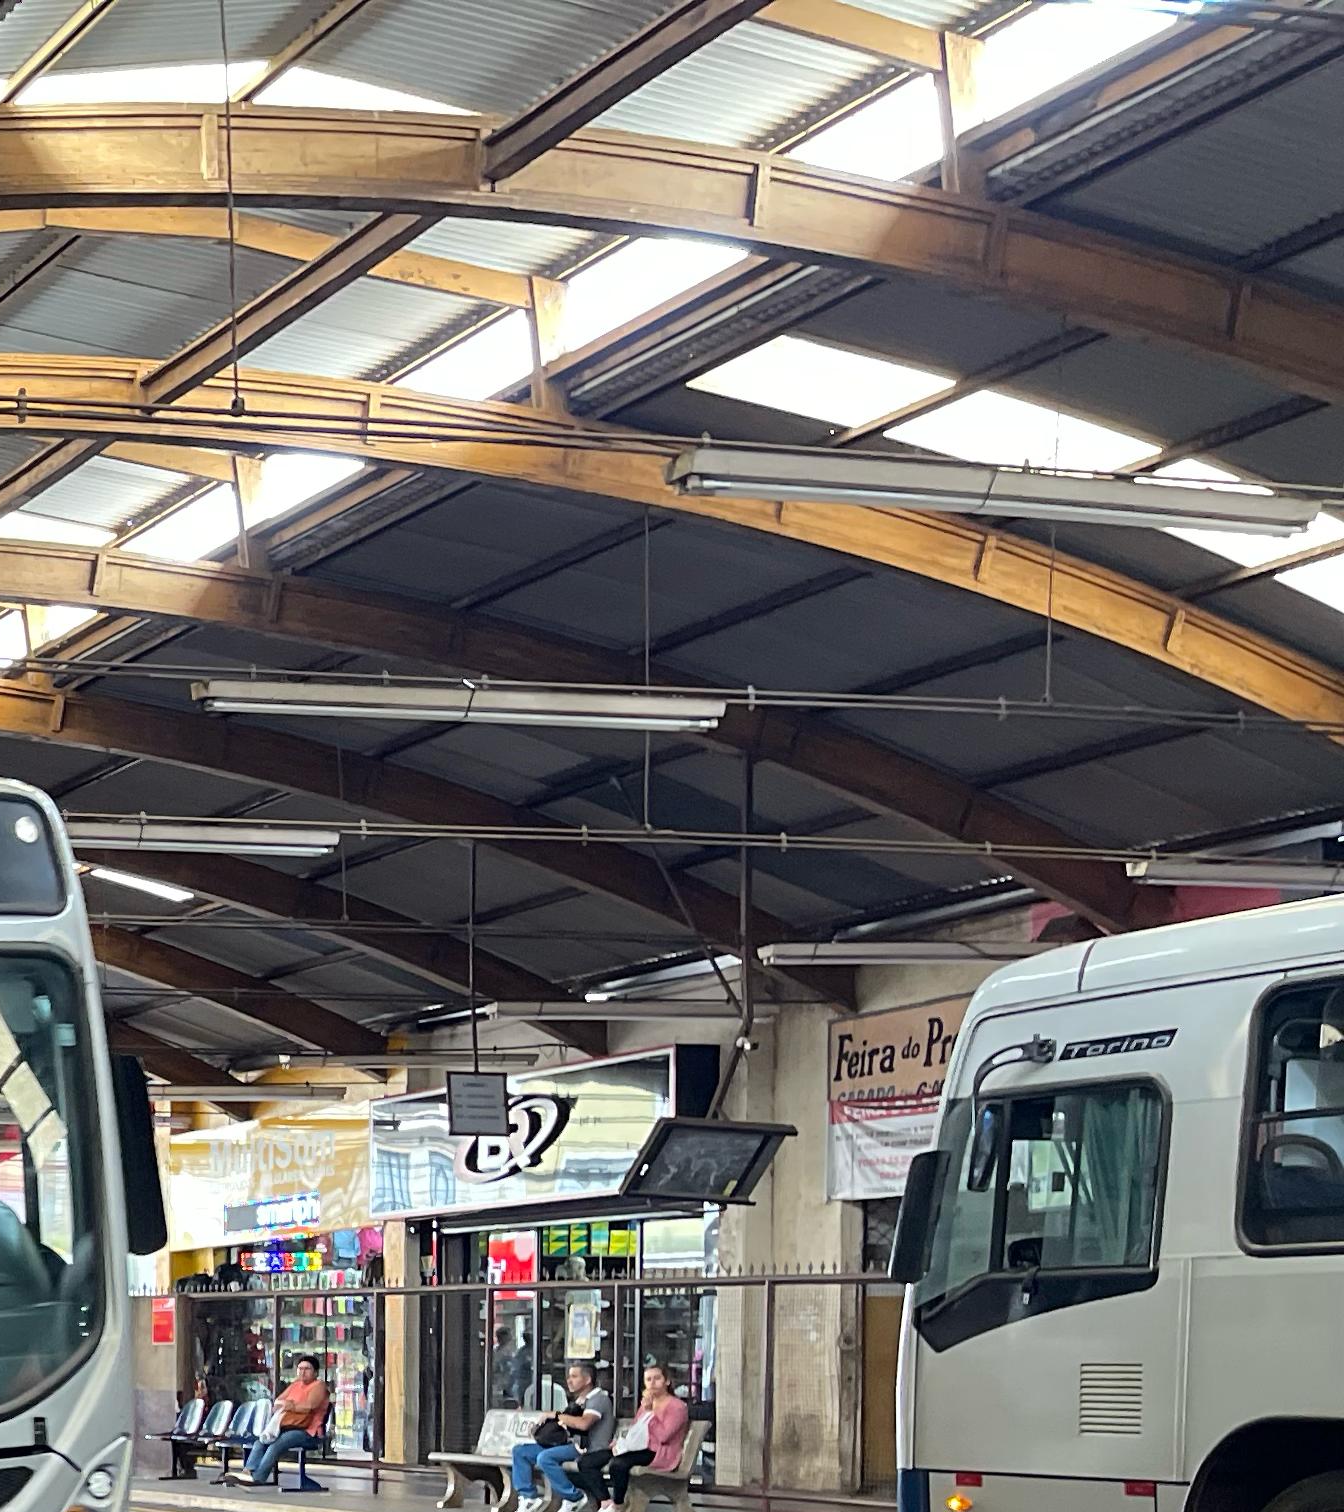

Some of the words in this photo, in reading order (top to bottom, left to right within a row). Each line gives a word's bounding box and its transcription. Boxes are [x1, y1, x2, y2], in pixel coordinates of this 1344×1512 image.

[833, 1033, 896, 1082] Feira
[901, 1036, 921, 1060] do
[1067, 1035, 1172, 1058] Torino
